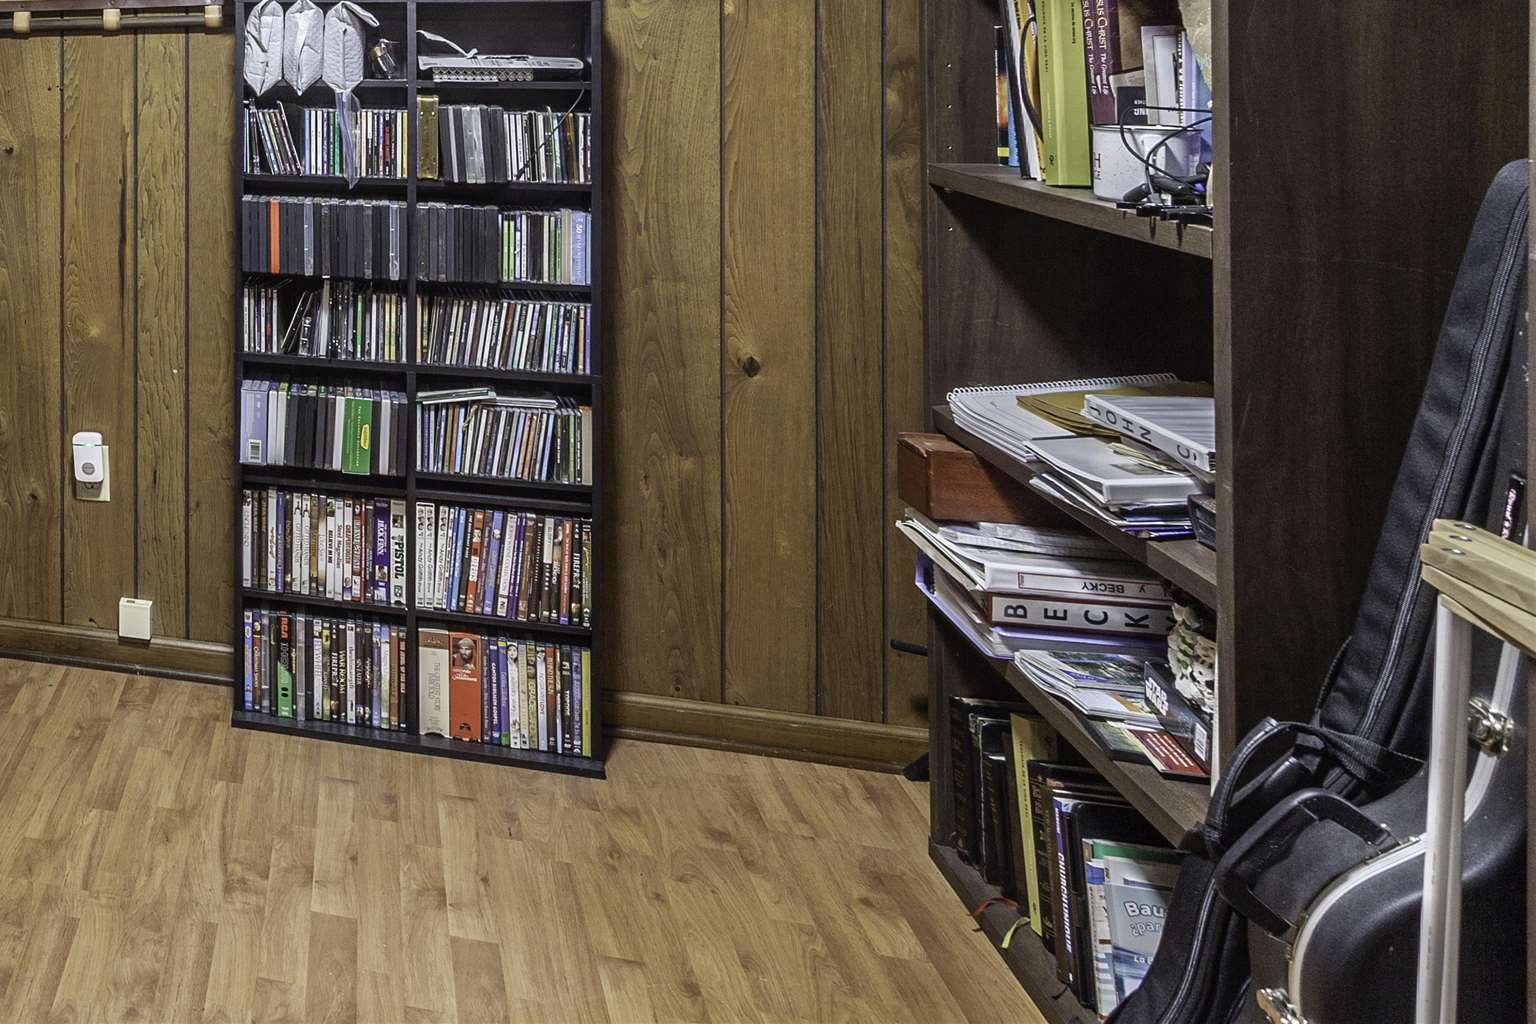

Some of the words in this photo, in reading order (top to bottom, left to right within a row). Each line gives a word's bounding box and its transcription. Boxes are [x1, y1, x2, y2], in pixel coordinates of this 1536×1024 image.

[1085, 18, 1094, 49] CHRIST
[1098, 17, 1108, 49] CHRIST
[1089, 406, 1152, 442] JOHN
[394, 542, 404, 579] PISTOL
[1082, 581, 1125, 593] BECKY
[1057, 852, 1068, 904] CHURCH
[1124, 900, 1167, 918] Bau
